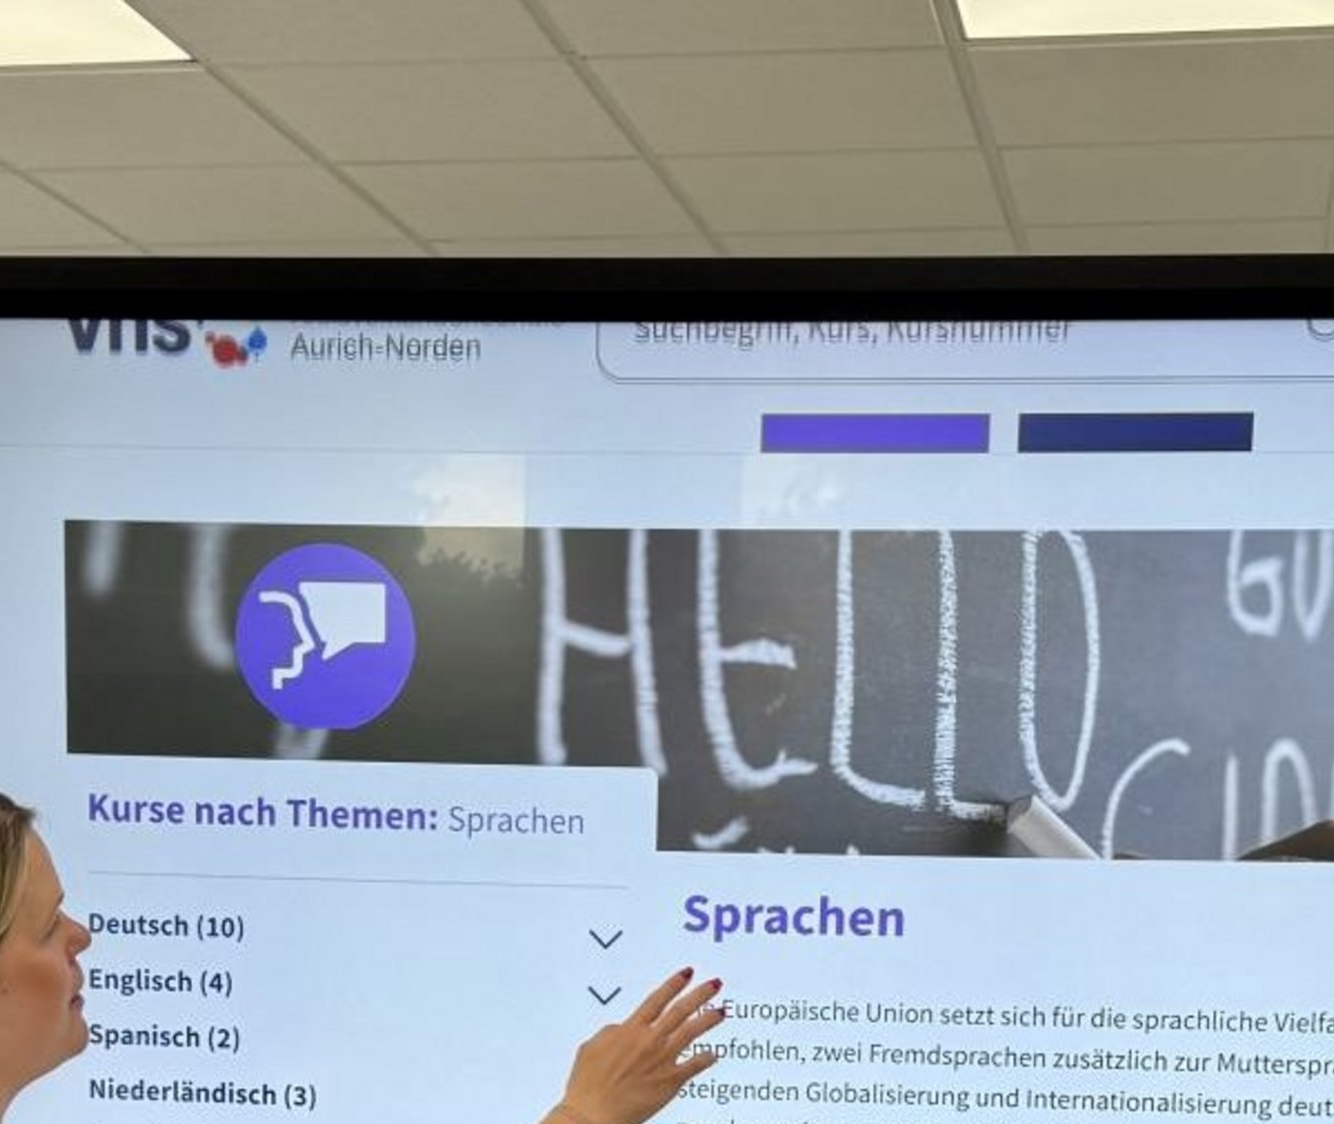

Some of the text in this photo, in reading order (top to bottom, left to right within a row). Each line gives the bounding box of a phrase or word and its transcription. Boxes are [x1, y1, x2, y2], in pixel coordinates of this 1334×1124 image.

[290, 332, 482, 361] Aurich-Norden
[88, 793, 585, 839] Kurse nach Themen: Sprachen
[88, 912, 244, 943] Deutsch (10)
[683, 894, 905, 943] Sprachen
[89, 968, 233, 998] Englisch (4)
[722, 998, 860, 1025] Europäische
[865, 1002, 934, 1024] Union
[940, 1006, 995, 1026] setzt
[1000, 1005, 1046, 1028] sich
[1052, 1005, 1086, 1028] für
[1090, 1007, 1127, 1030] die
[1132, 1009, 1269, 1035] sprachliche
[88, 1023, 240, 1054] Spanisch (2)
[811, 1042, 862, 1064] zwei
[869, 1043, 1047, 1071] Fremdsprachen
[1052, 1048, 1168, 1072] zusätzlich
[1173, 1055, 1212, 1073] zur
[89, 1077, 317, 1111] Niederländisch (3)
[679, 1079, 800, 1105] steigenden
[805, 1081, 971, 1113] Globalisierung
[975, 1087, 1020, 1109] und
[1026, 1089, 1273, 1122] Internationalisierung
